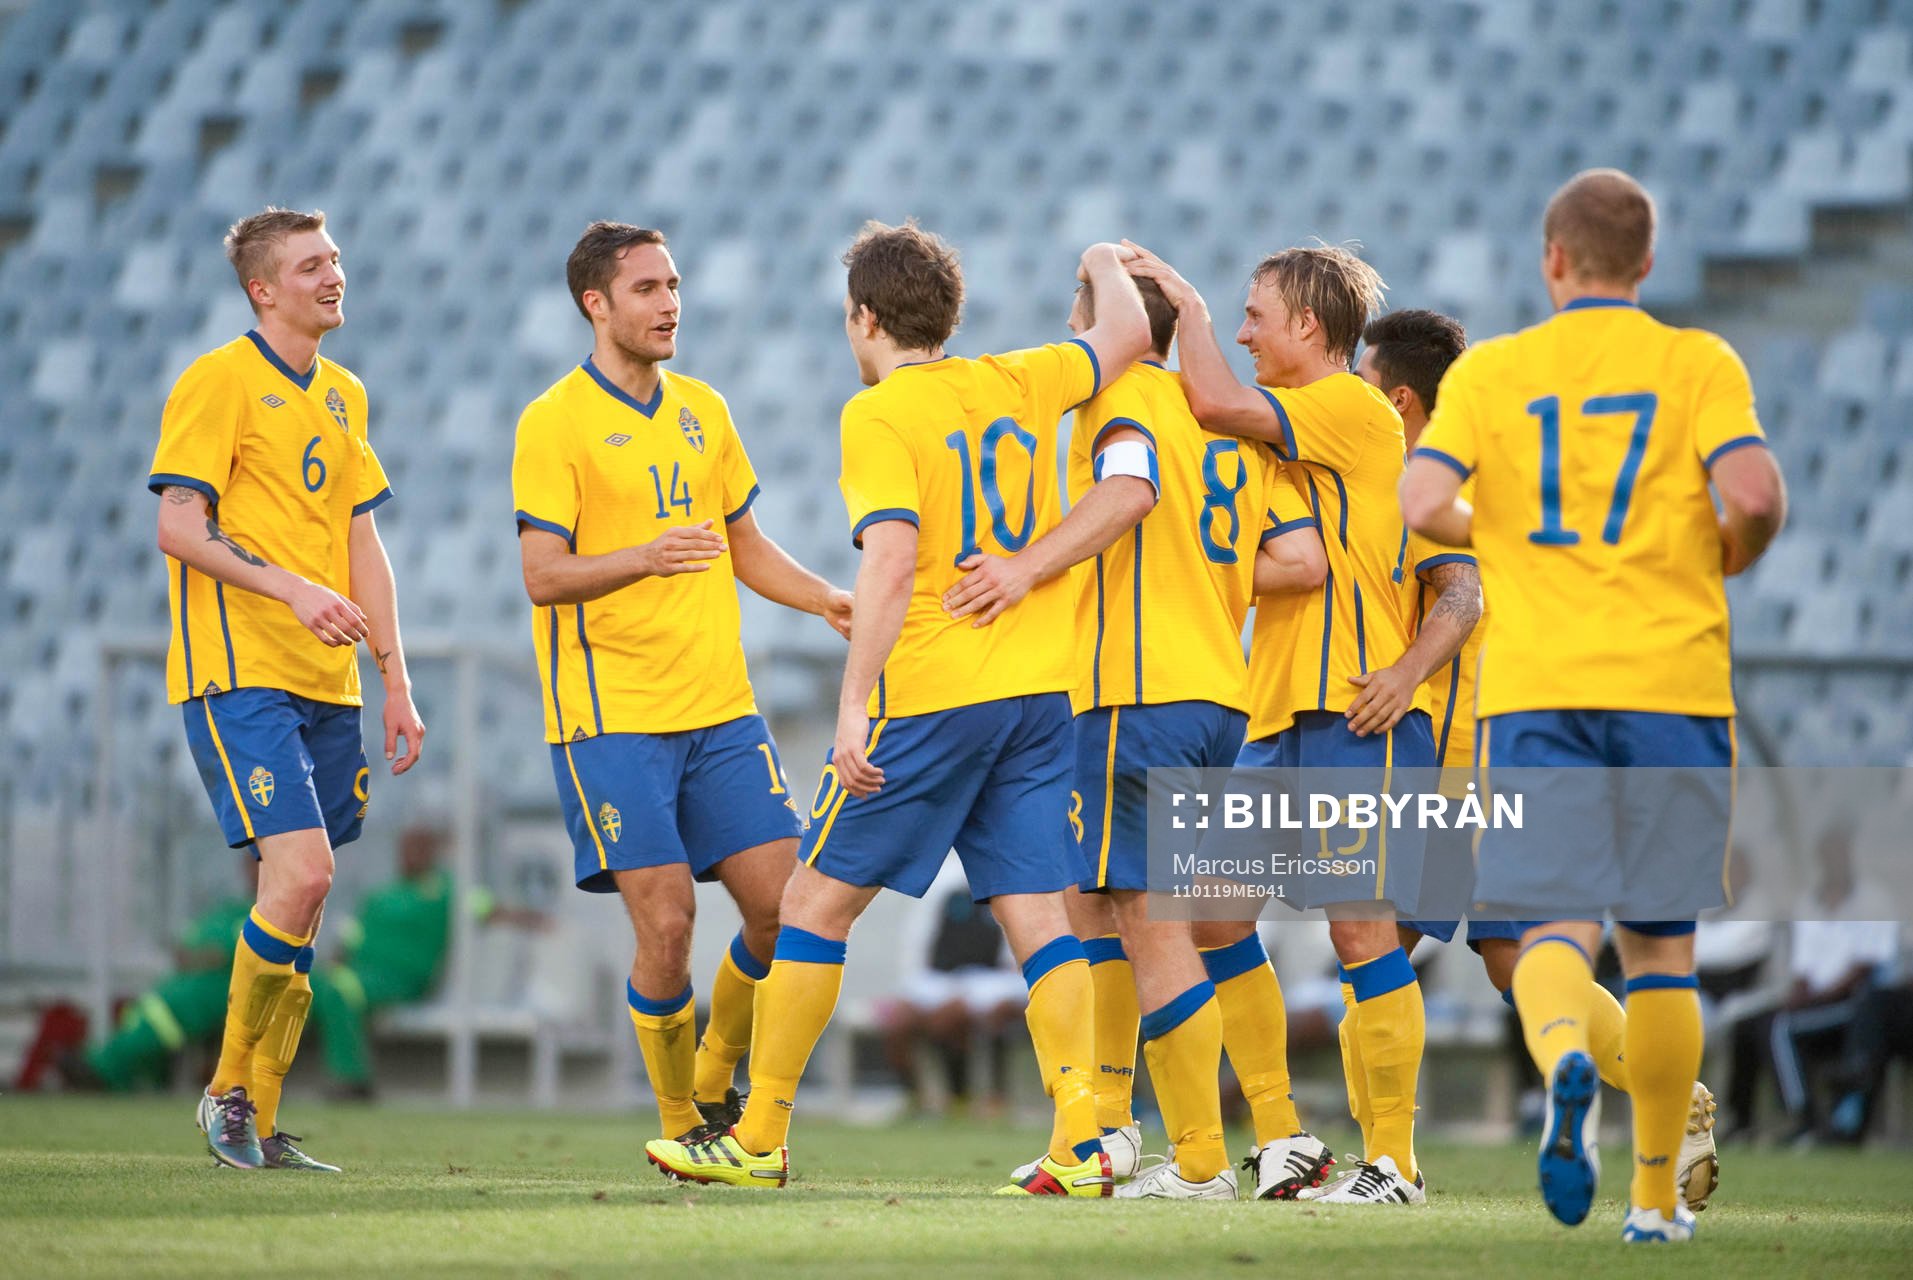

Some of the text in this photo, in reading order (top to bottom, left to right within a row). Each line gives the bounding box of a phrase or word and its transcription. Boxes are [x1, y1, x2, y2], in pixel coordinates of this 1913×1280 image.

[302, 435, 326, 493] 6
[648, 461, 693, 519] 14
[945, 416, 1038, 568] 10
[1198, 438, 1248, 565] 8
[1526, 392, 1658, 546] 17
